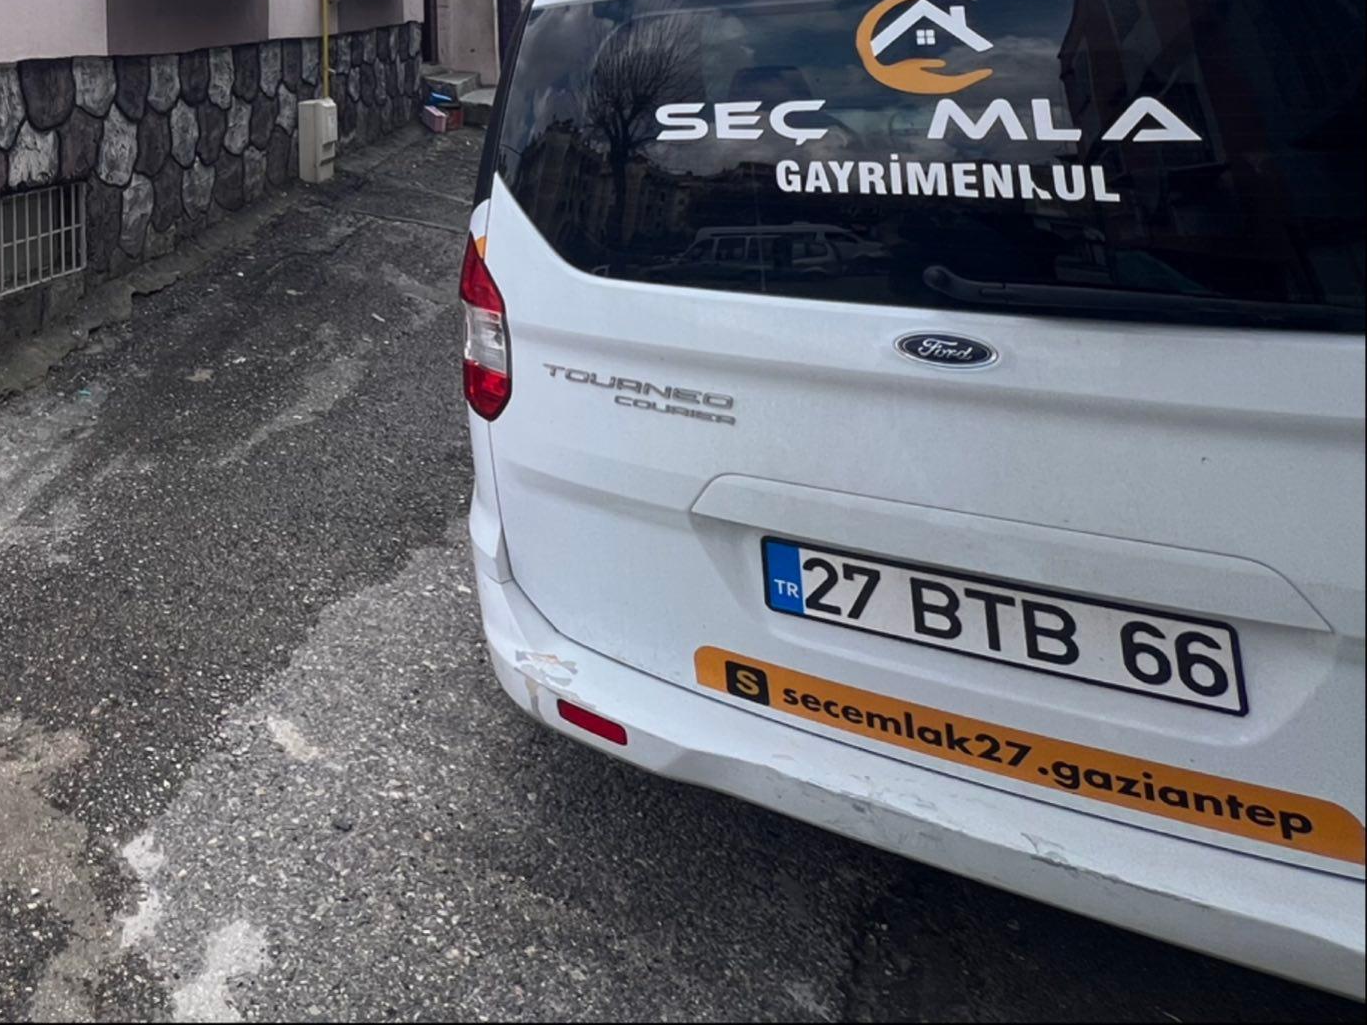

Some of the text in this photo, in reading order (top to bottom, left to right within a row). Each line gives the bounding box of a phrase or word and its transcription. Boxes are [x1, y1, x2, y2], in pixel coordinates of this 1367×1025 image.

[654, 99, 828, 145] SEÇ
[915, 337, 974, 362] Ford
[542, 362, 735, 410] TOURNEO
[613, 395, 736, 426] COURIER
[774, 578, 799, 599] TR
[802, 557, 1229, 697] 27 BTB 66
[782, 687, 1314, 840] secemlak27.gaziantep
